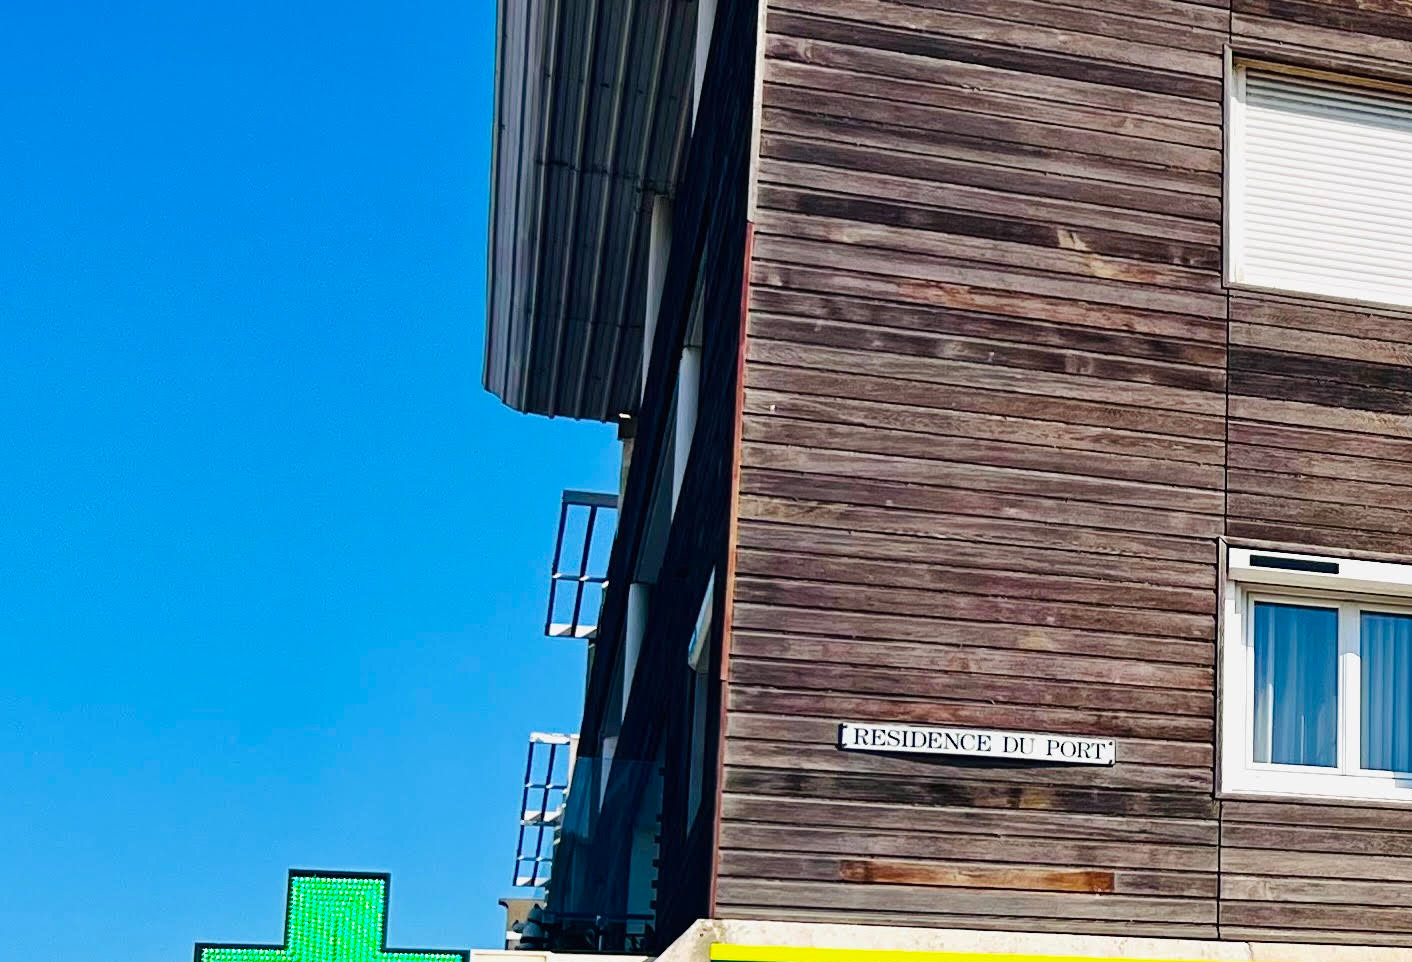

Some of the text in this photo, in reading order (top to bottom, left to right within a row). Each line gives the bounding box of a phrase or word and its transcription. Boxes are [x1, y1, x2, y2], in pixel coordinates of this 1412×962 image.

[853, 727, 1106, 760] RESIDENCE DU PORT
